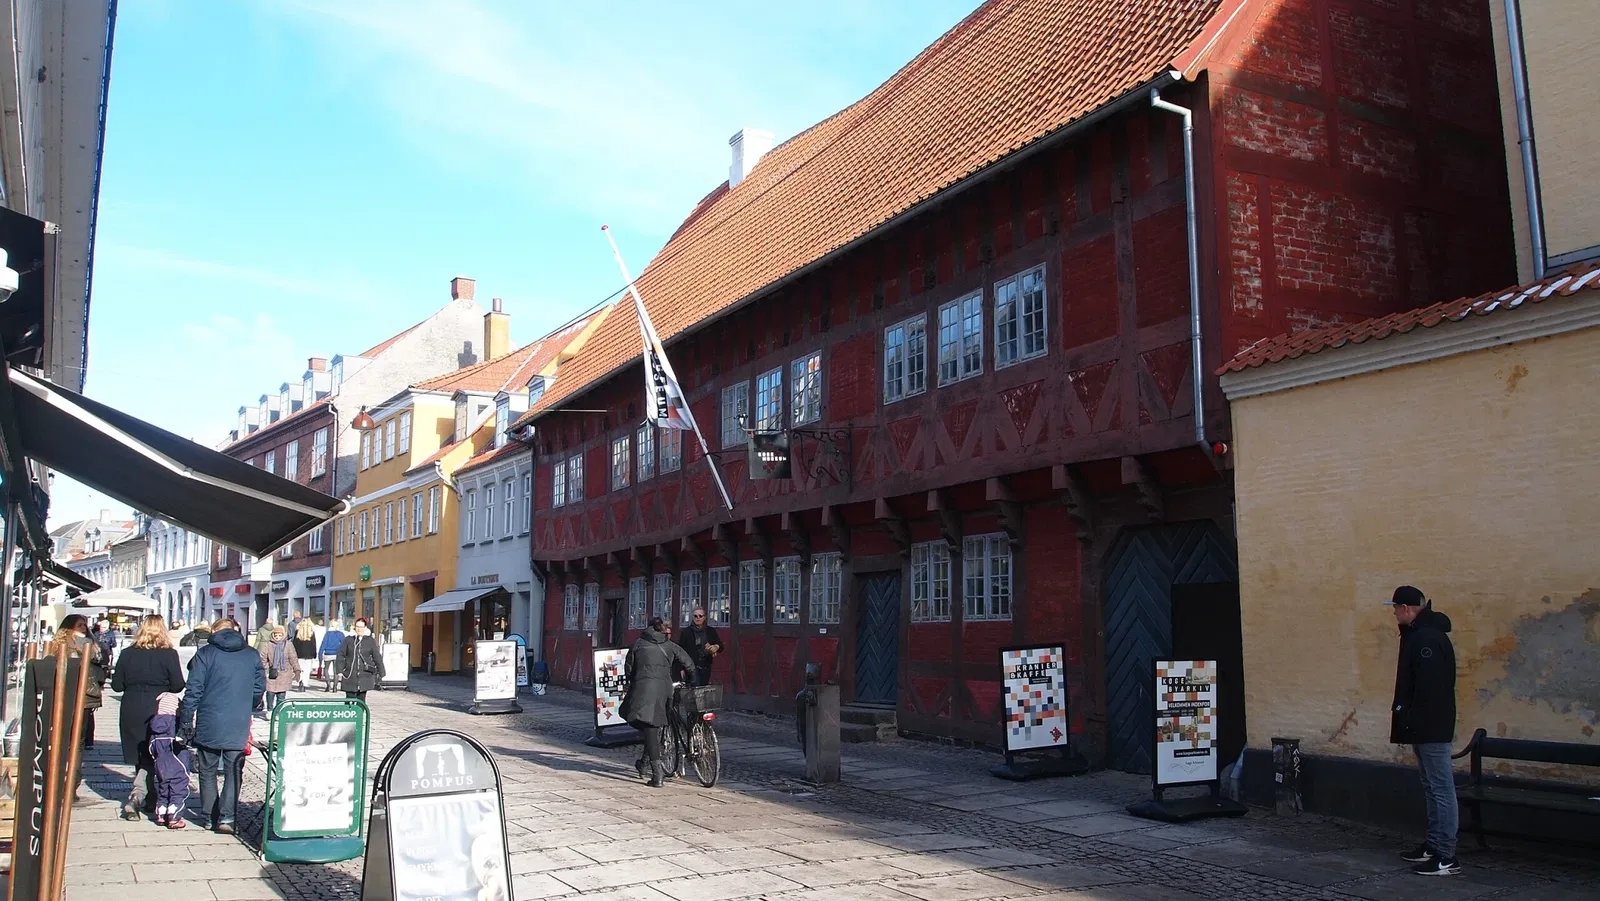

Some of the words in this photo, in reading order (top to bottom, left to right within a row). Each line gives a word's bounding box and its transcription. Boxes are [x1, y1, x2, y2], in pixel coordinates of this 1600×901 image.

[470, 576, 476, 585] LA
[1016, 662, 1057, 671] KRANIER
[1168, 685, 1210, 693] BYARKIV
[286, 710, 304, 719] THE
[306, 710, 331, 719] BODY
[411, 775, 474, 790] POMPUS
[290, 786, 308, 808] 3
[326, 786, 344, 805] 2
